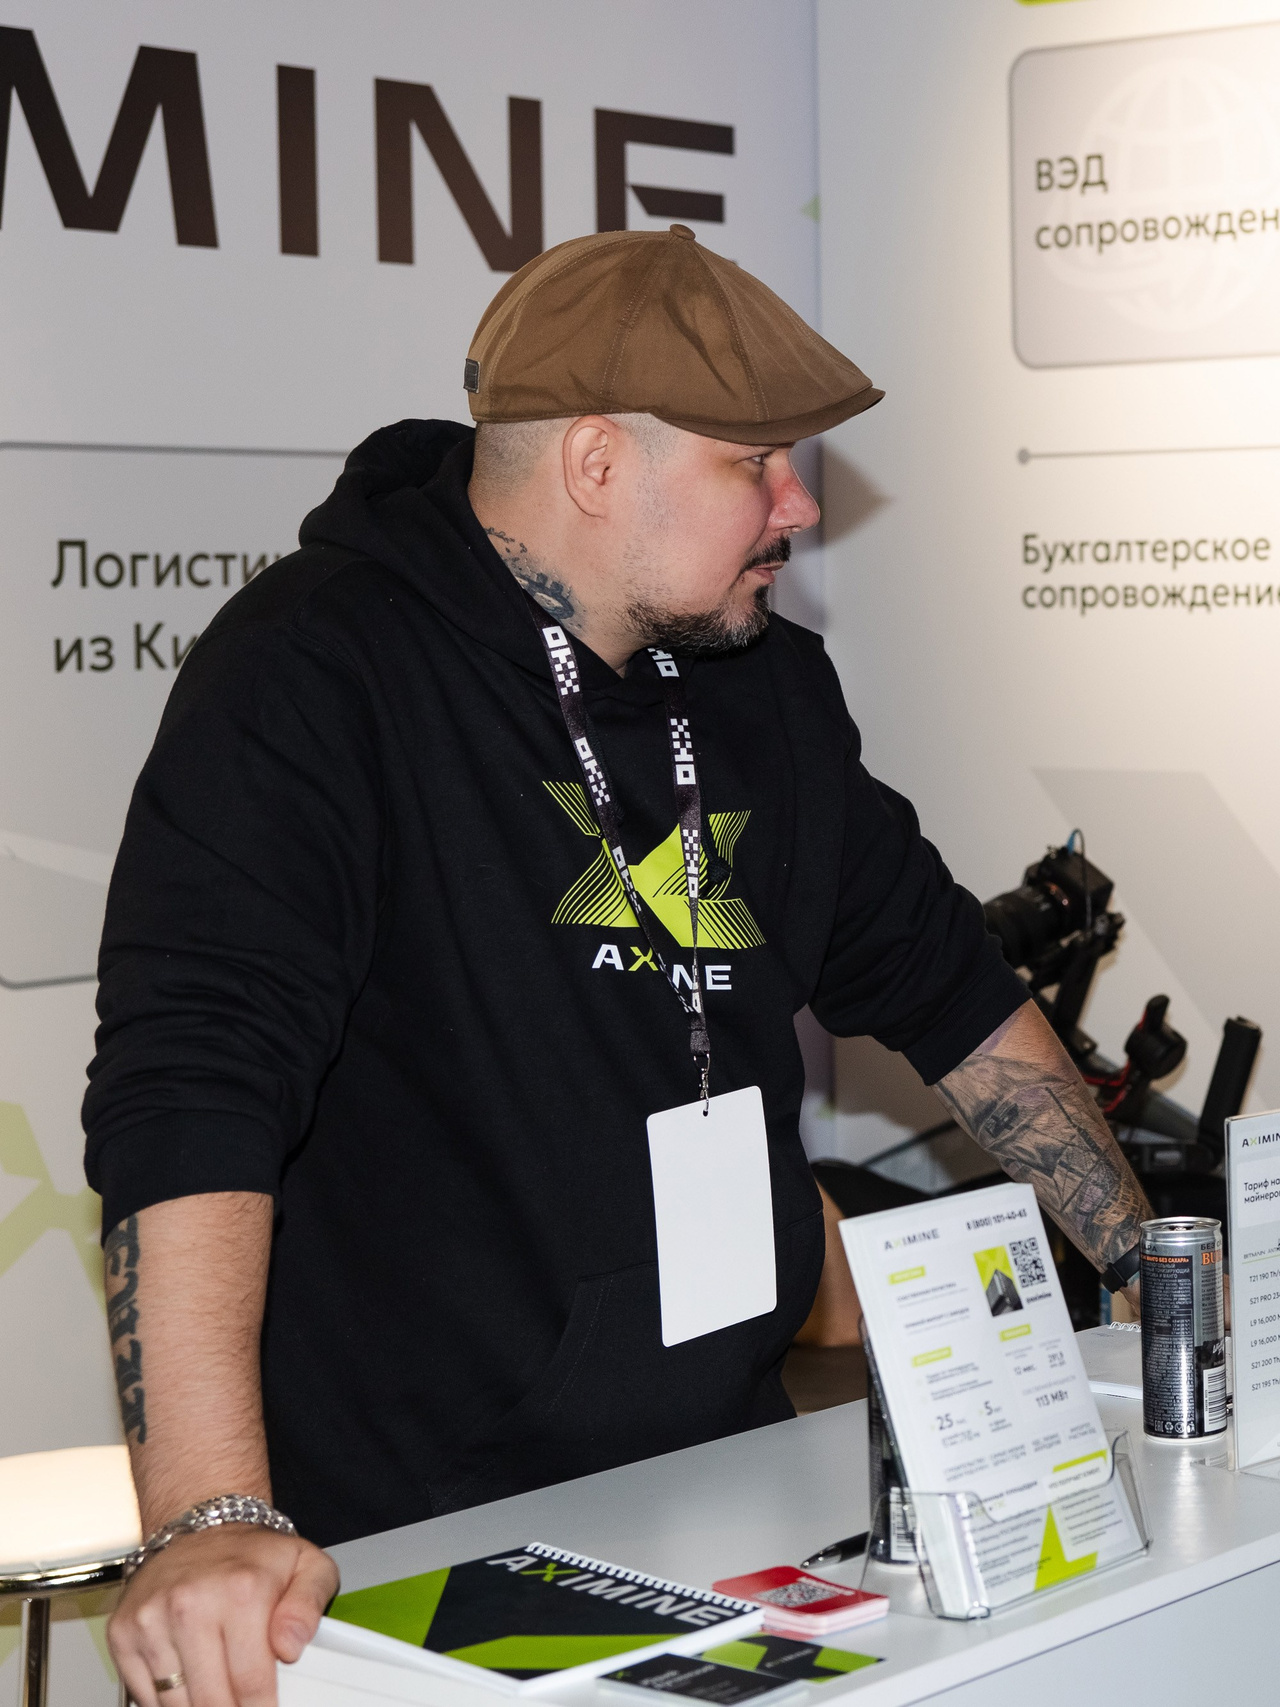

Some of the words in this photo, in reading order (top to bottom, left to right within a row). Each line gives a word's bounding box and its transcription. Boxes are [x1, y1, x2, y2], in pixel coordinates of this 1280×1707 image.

[1036, 153, 1108, 195] ВЭД
[1022, 534, 1272, 574] Бухгалтерское
[51, 538, 283, 589] Логисти
[54, 635, 115, 674] из
[1244, 1179, 1269, 1192] Тариф
[884, 1229, 940, 1251] AXIMINE
[1250, 1297, 1259, 1305] S21
[1260, 1293, 1272, 1302] PRO
[1250, 1319, 1257, 1327] L9
[1250, 1339, 1258, 1347] L9
[1251, 1361, 1261, 1369] S21
[1261, 1358, 1273, 1367] 200
[1251, 1383, 1261, 1391] S21
[984, 1400, 993, 1415] 5
[936, 1413, 954, 1431] 25
[485, 1555, 736, 1627] AXIMINE
